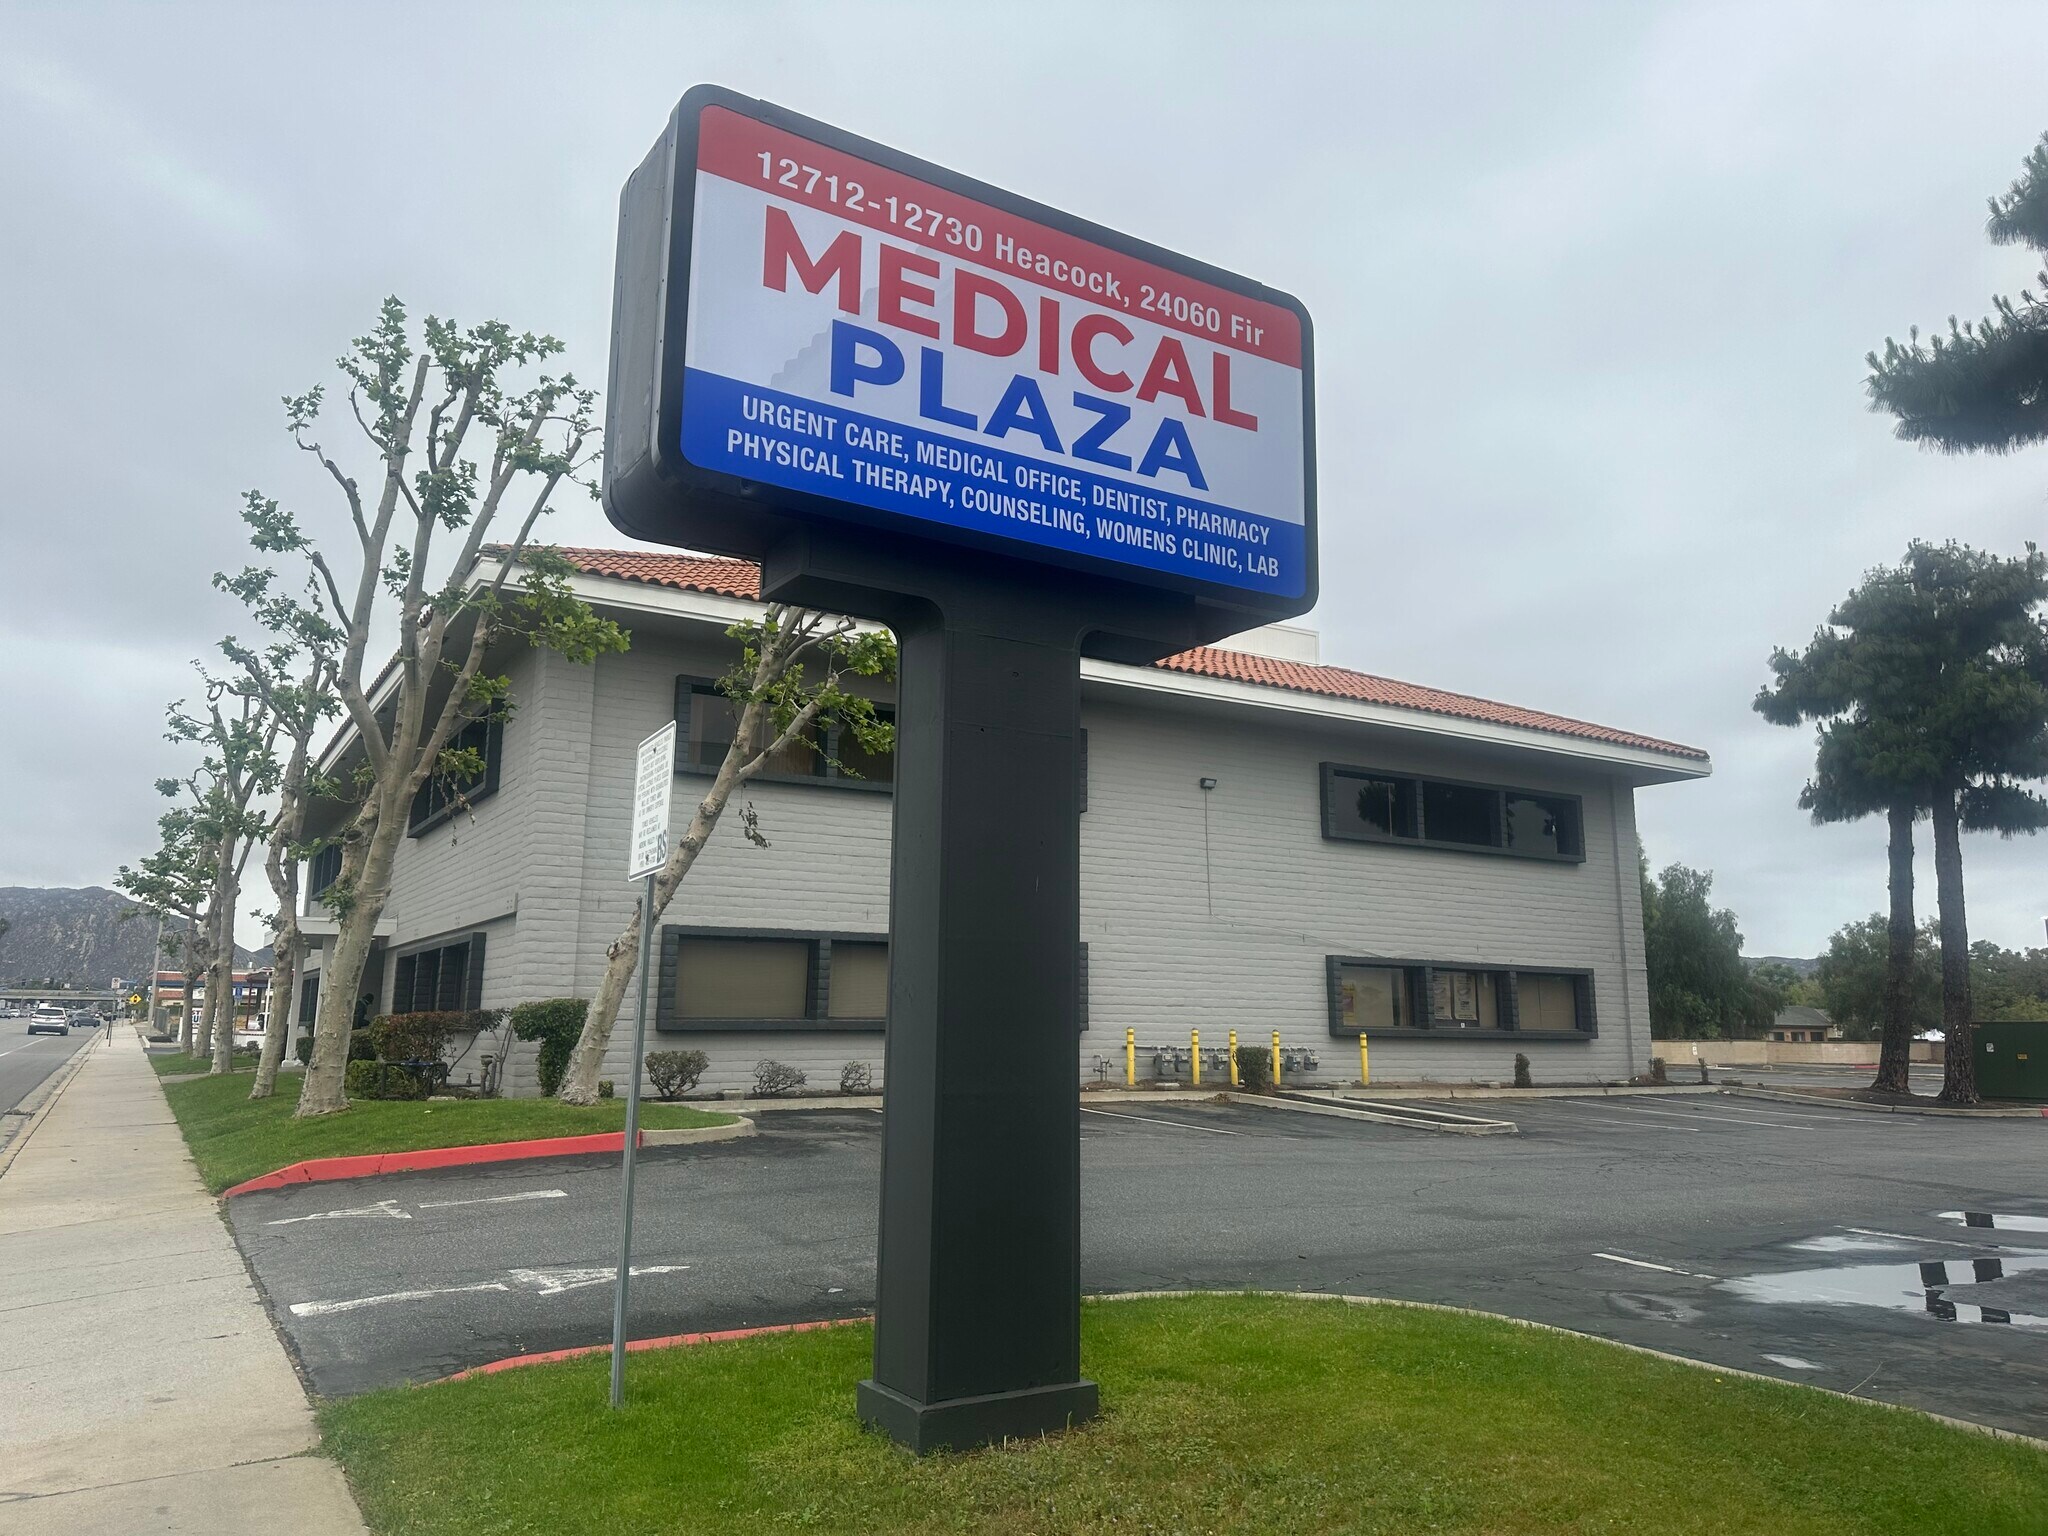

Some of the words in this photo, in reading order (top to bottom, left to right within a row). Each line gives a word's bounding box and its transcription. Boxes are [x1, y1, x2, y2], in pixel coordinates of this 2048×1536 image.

[757, 151, 983, 252] 12712-12730
[995, 233, 1131, 308] Heacock,
[1140, 285, 1221, 333] 24060
[1231, 314, 1264, 346] Fir
[763, 204, 1258, 432] MEDICAL
[742, 394, 838, 441] URGENT
[845, 422, 910, 465] CARE,
[916, 440, 1009, 484] MEDICAL
[1015, 465, 1087, 507] OFFICE,
[1093, 484, 1172, 527] DENTIST,
[1176, 505, 1270, 546] PHARMACY
[830, 319, 1209, 491] PLAZA
[727, 428, 844, 479] PHYSICAL
[851, 459, 955, 509] THERAPY,
[961, 486, 1091, 540] COUNSELING,
[1096, 517, 1177, 555] WOMENS
[1182, 537, 1243, 574] CLINIC,
[1247, 552, 1279, 577] LAB
